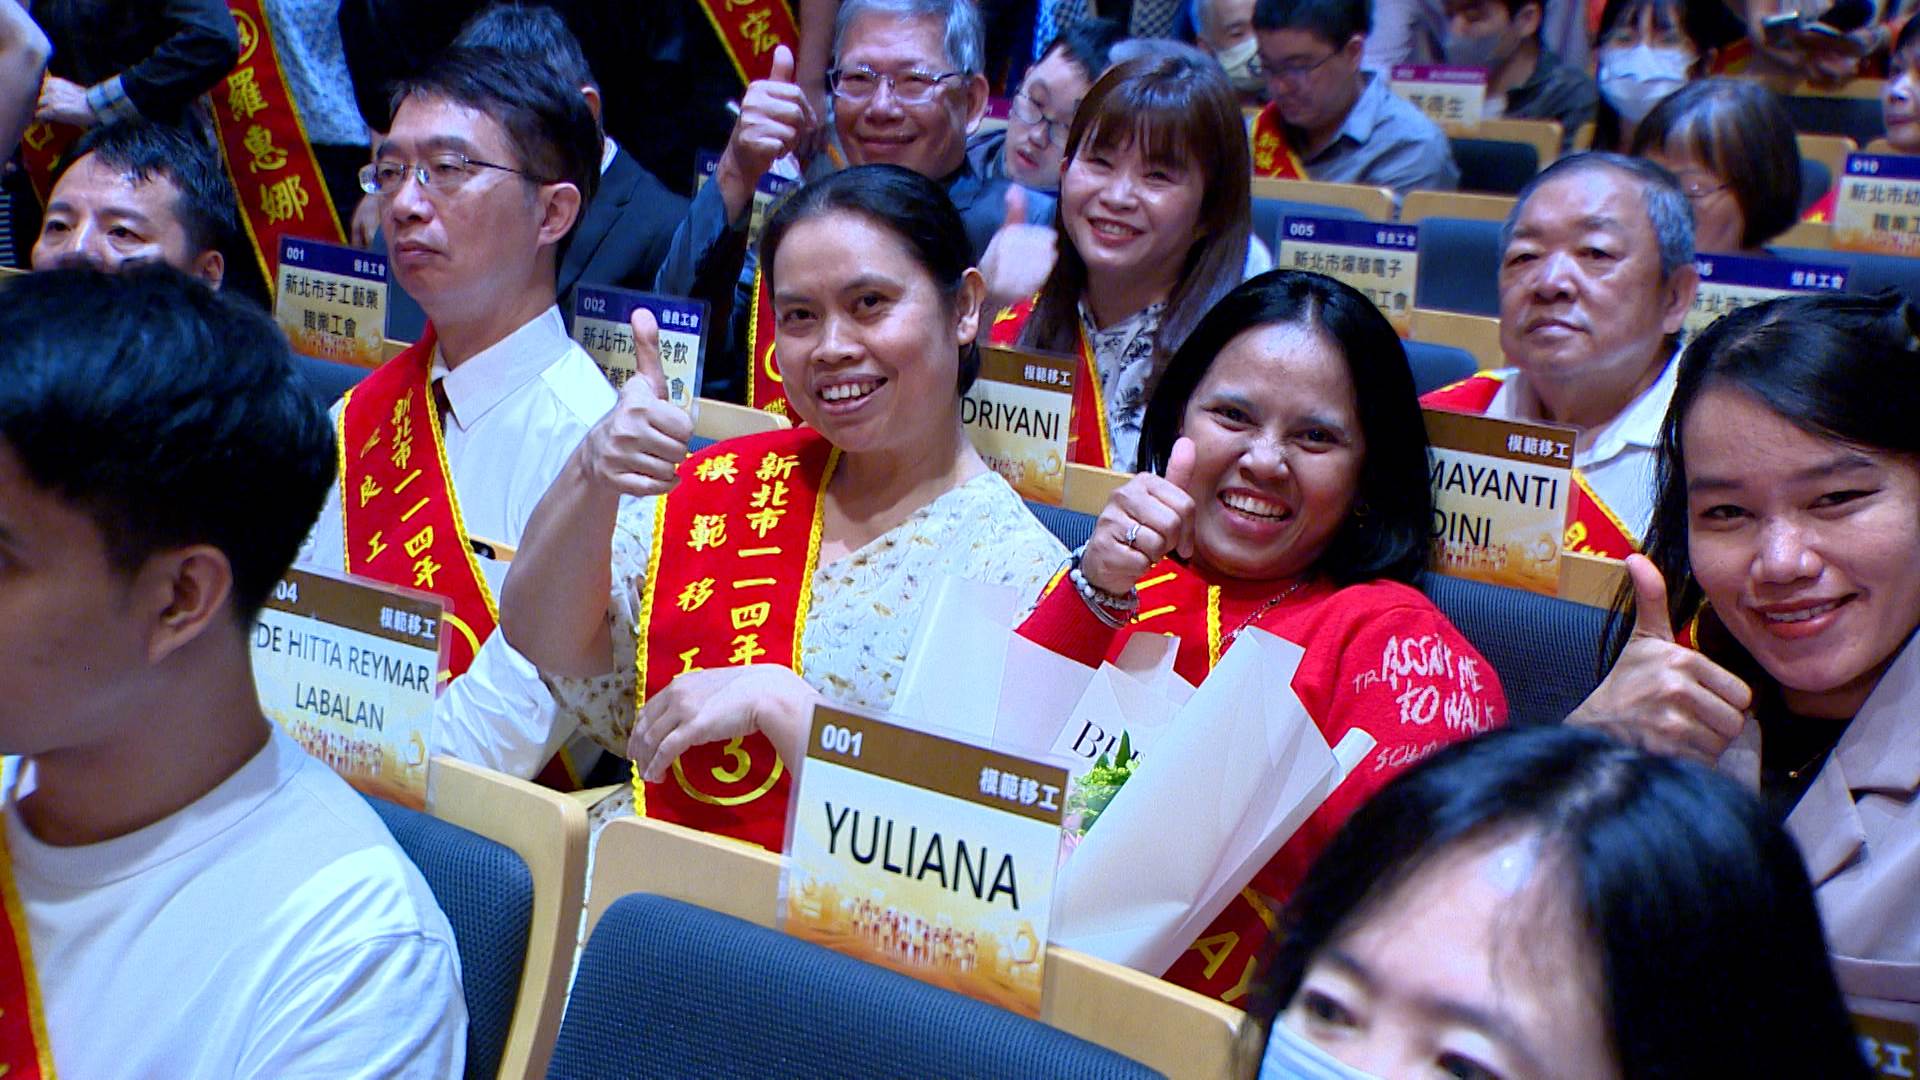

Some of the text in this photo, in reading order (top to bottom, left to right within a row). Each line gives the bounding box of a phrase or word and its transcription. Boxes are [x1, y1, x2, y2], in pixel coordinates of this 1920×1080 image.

[1289, 222, 1315, 236] 005
[1376, 231, 1416, 247] 優良工會
[286, 247, 305, 261] 001
[354, 258, 386, 276] 優良工會
[285, 273, 379, 310] 新北市手工藝業
[1791, 270, 1844, 290] 優良工會
[583, 296, 606, 313] 002
[661, 308, 699, 329] 優良工會
[303, 308, 357, 339] 職業工會
[1023, 363, 1071, 387] 模範移工
[1507, 432, 1570, 460] 模範移工
[728, 451, 800, 666] 新北市一一四年
[380, 606, 437, 641] 模範移工
[256, 622, 431, 694] DE HITTA REYMAR
[295, 683, 385, 733] LABALAN
[820, 723, 864, 758] 001
[711, 736, 751, 784] 3
[979, 766, 1061, 811] 模範移工
[824, 801, 1020, 911] YULIANA
